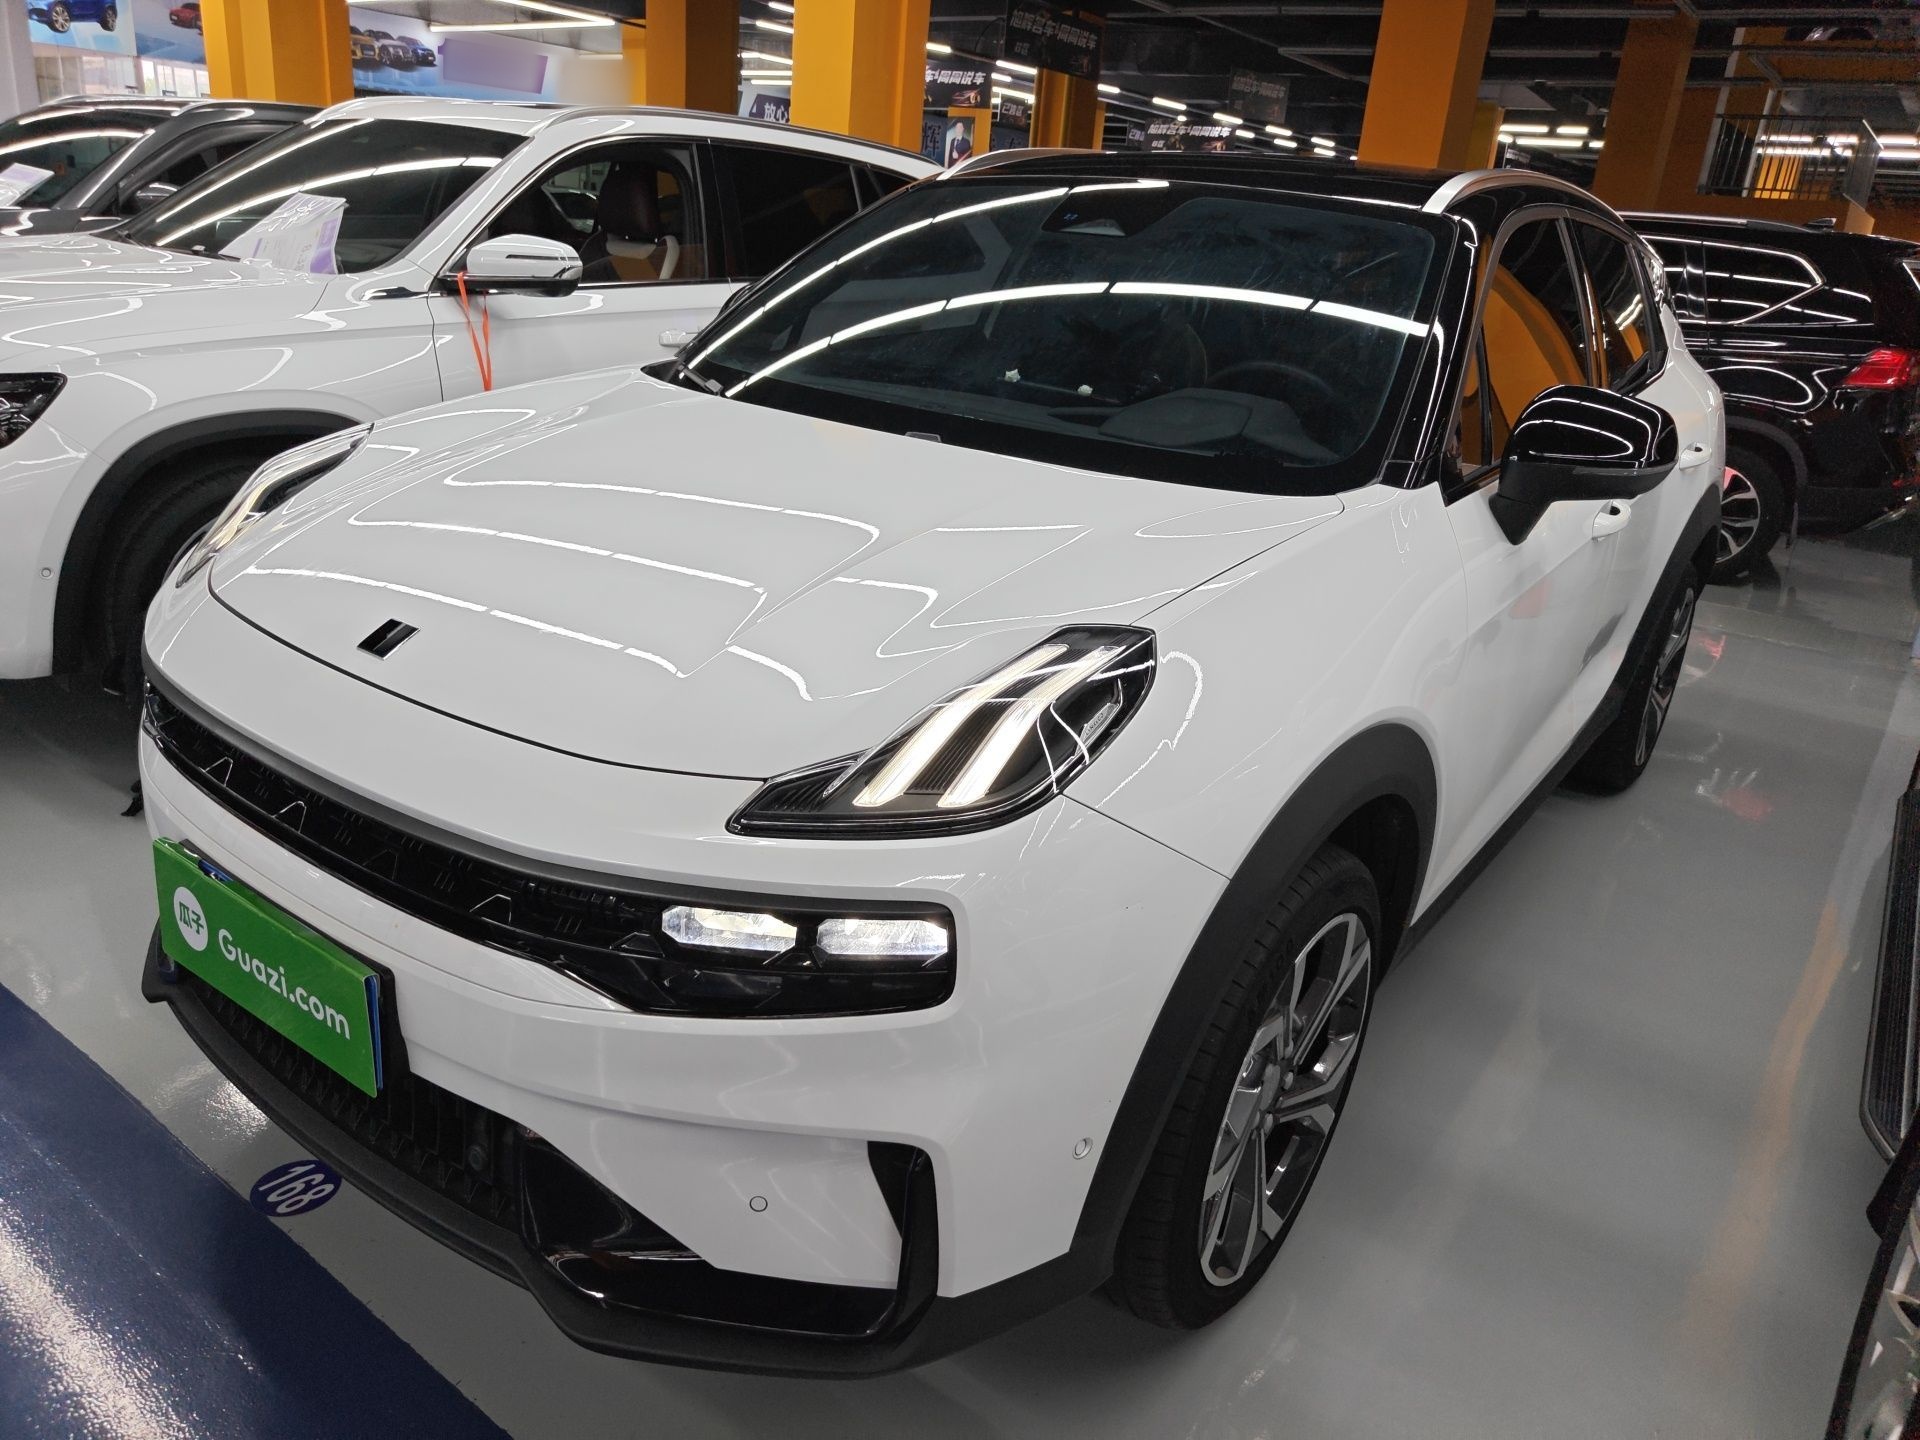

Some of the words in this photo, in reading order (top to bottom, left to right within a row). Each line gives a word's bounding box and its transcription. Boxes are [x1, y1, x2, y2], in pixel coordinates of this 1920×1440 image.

[179, 901, 205, 935] 瓜子
[218, 929, 350, 1040] Guazi.com
[258, 1164, 335, 1213] 168
